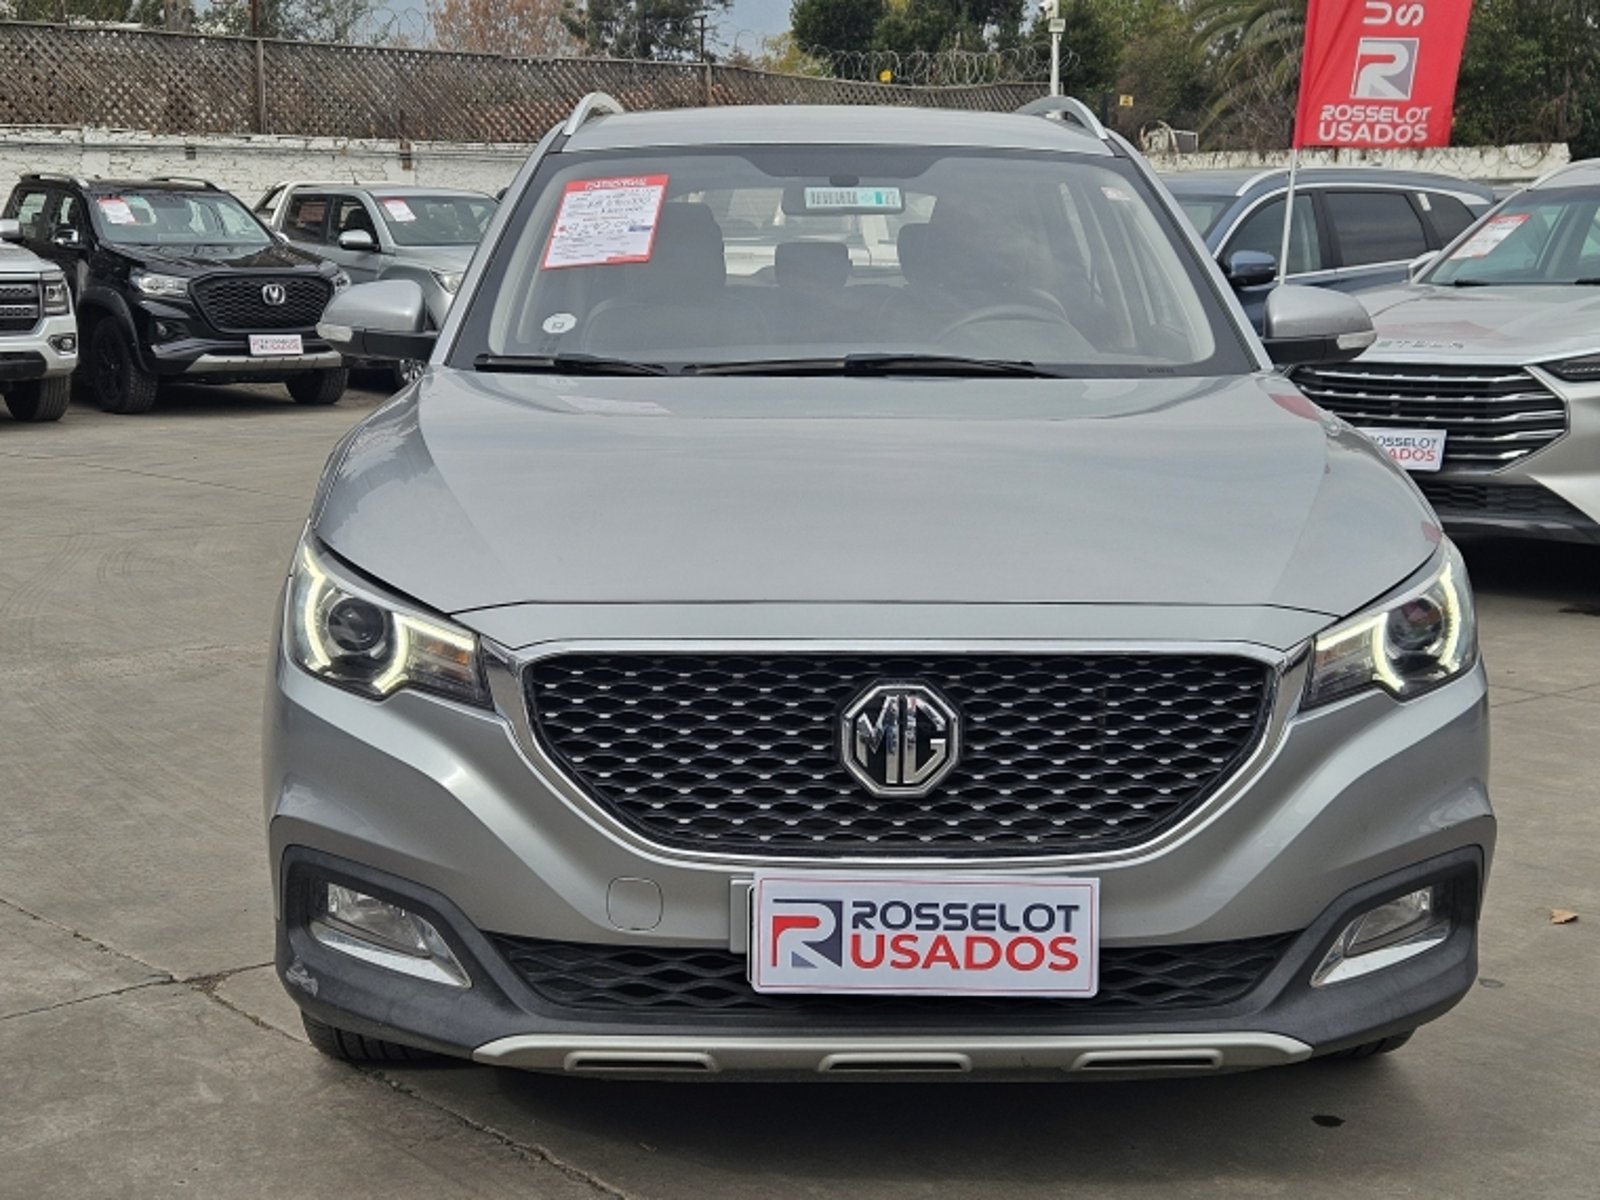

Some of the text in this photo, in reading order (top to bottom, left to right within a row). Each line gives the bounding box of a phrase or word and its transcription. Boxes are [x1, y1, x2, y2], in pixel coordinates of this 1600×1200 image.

[1320, 105, 1431, 124] ROSSELOT
[1319, 122, 1427, 143] USADOS
[1389, 448, 1435, 462] ADOS
[856, 694, 946, 784] MG
[852, 901, 1080, 934] ROSSELOT
[850, 934, 1079, 972] USADOS
